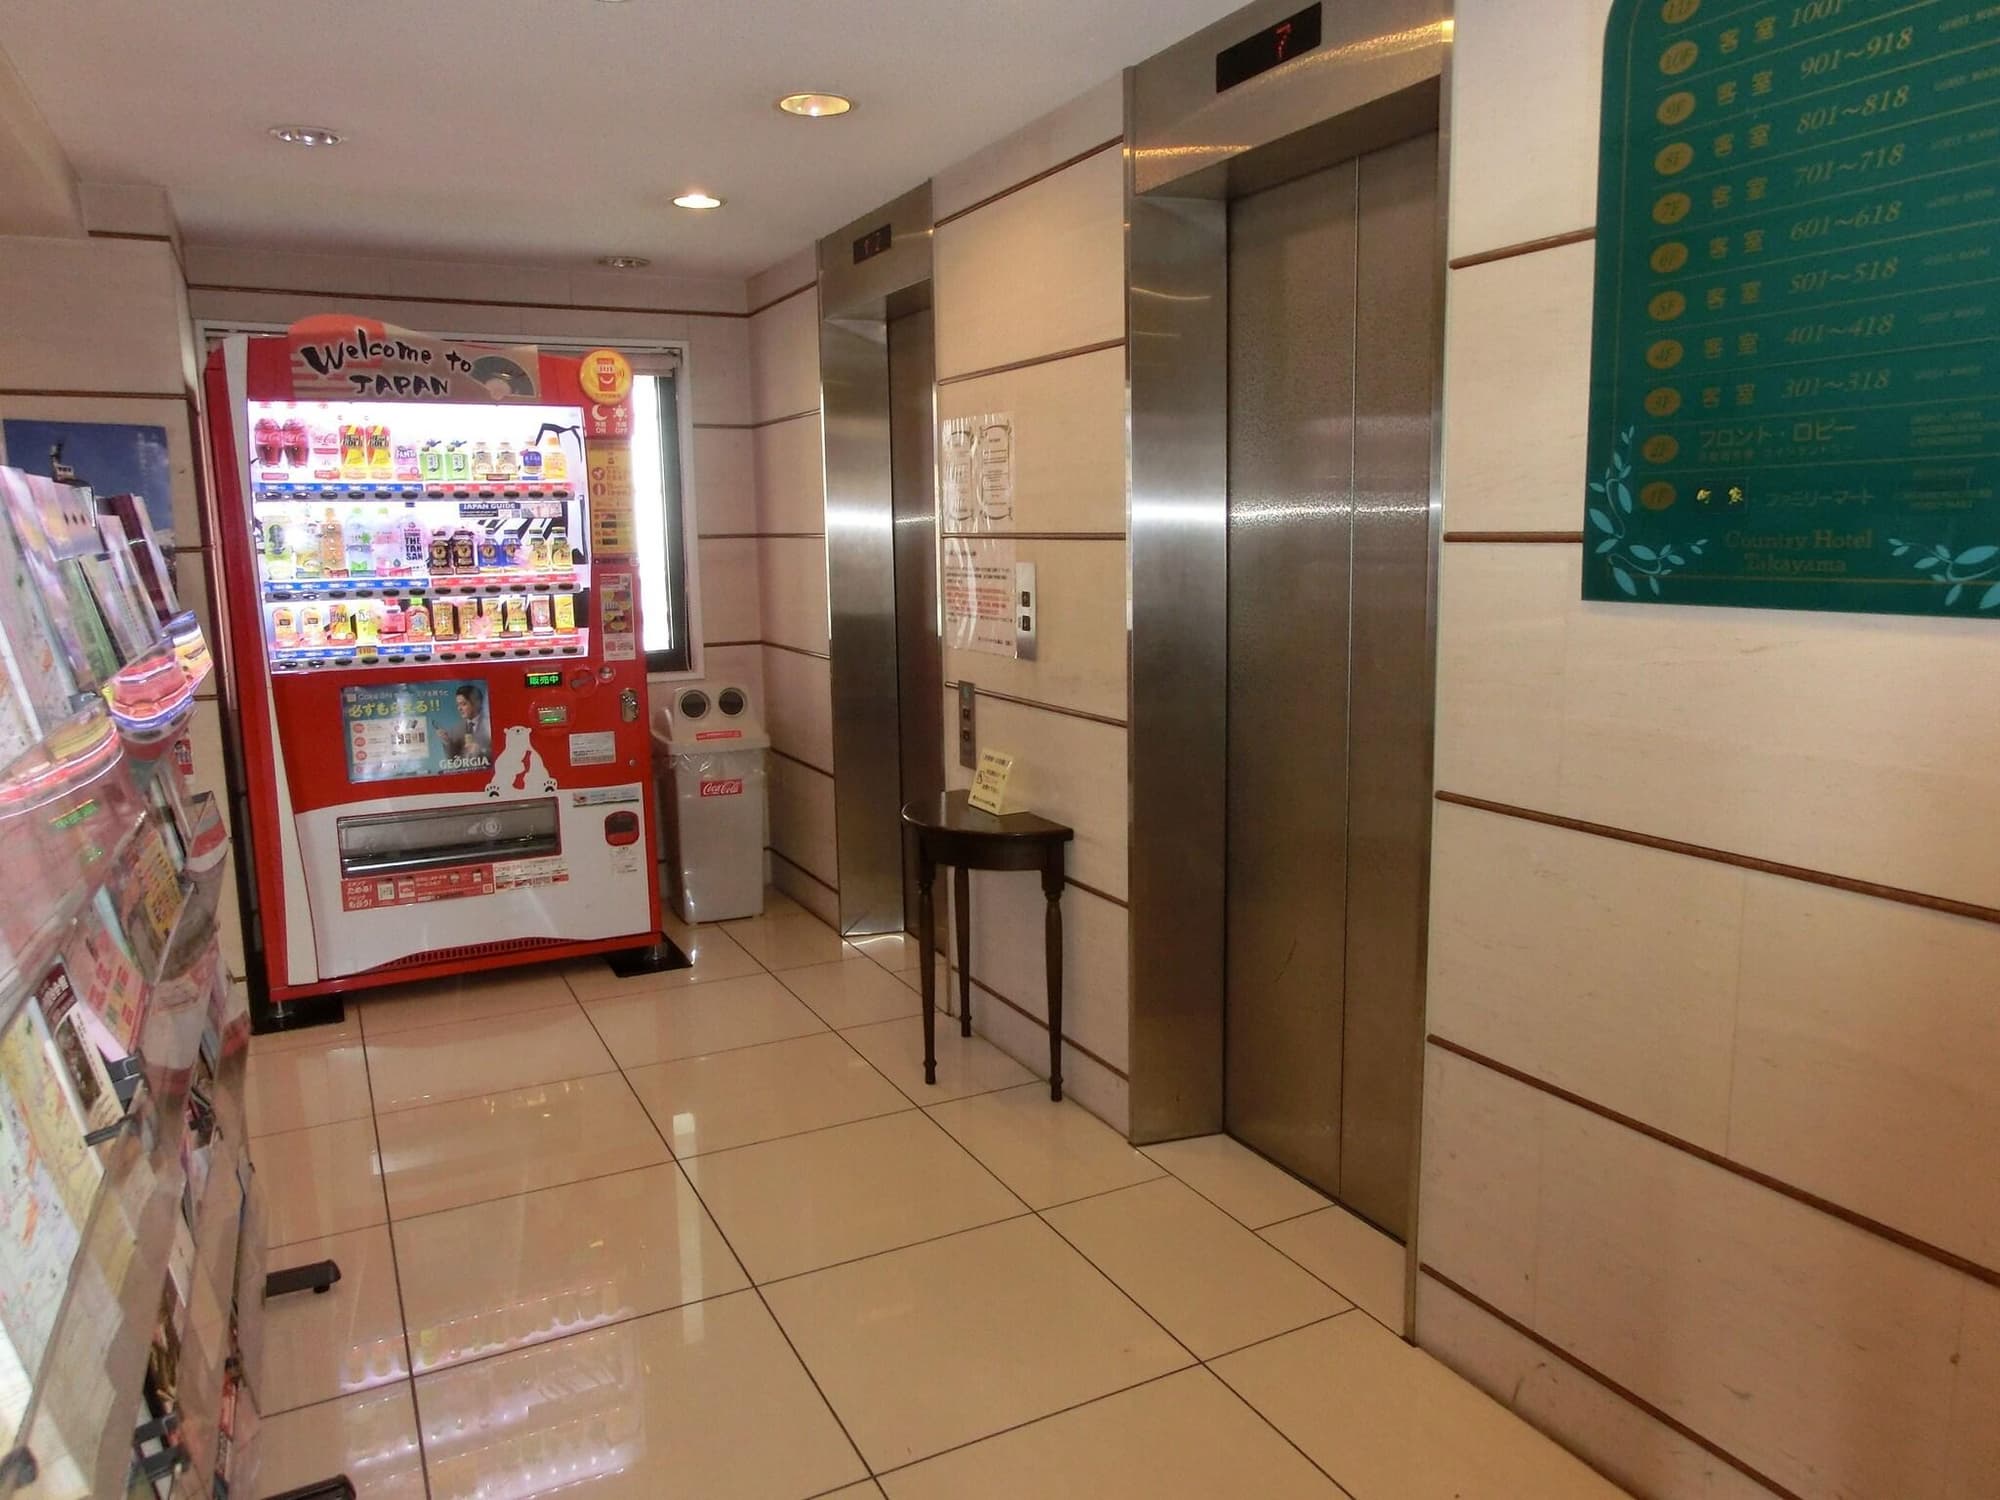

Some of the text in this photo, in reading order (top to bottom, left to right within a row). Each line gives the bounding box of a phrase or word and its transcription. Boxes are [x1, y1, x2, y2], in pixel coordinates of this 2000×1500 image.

[1277, 24, 1291, 59] 7
[301, 329, 473, 375] Welcome to
[350, 374, 449, 395] JAPAN
[1813, 528, 1872, 549] Hotel
[529, 675, 560, 686] 販売中
[439, 755, 490, 770] GEORGIA
